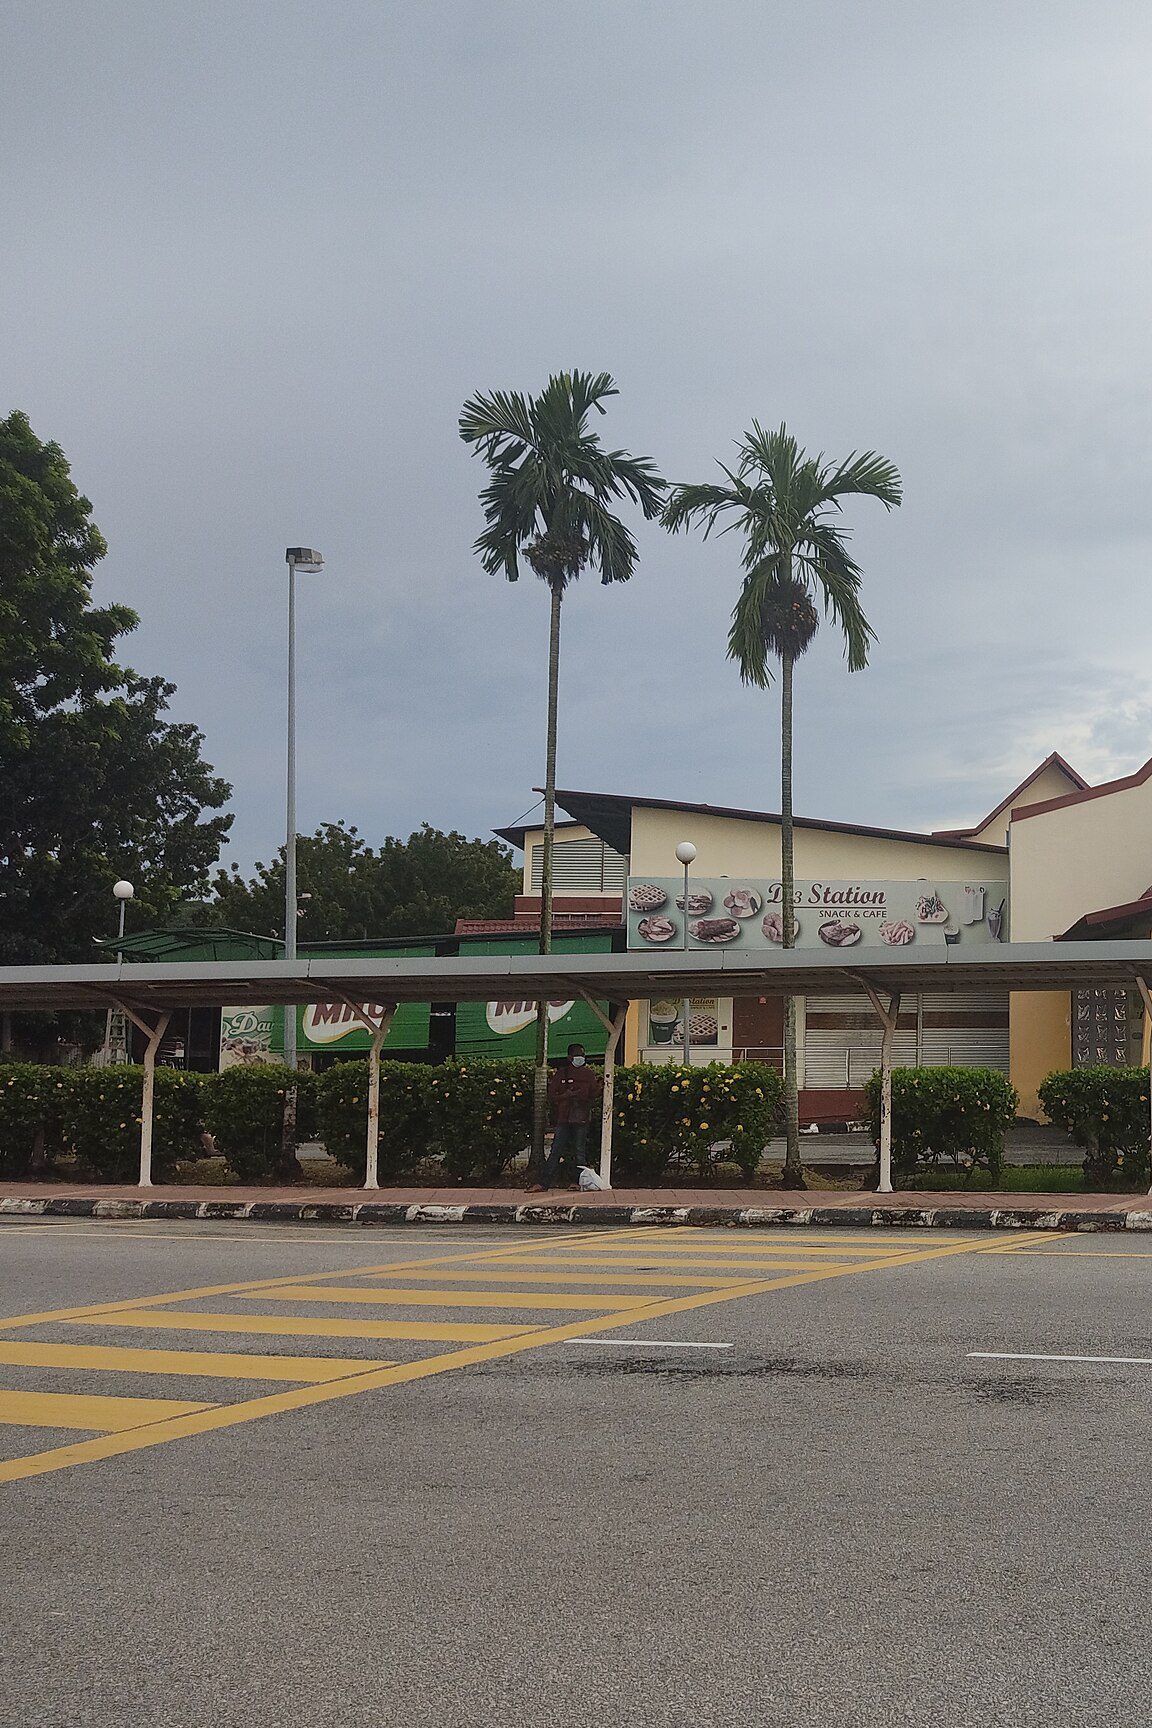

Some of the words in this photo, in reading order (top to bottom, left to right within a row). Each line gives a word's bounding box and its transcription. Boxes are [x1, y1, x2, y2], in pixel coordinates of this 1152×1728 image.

[808, 883, 887, 904] Station
[819, 910, 851, 918] SNACK
[853, 910, 861, 918] &
[862, 910, 887, 918] CAFE
